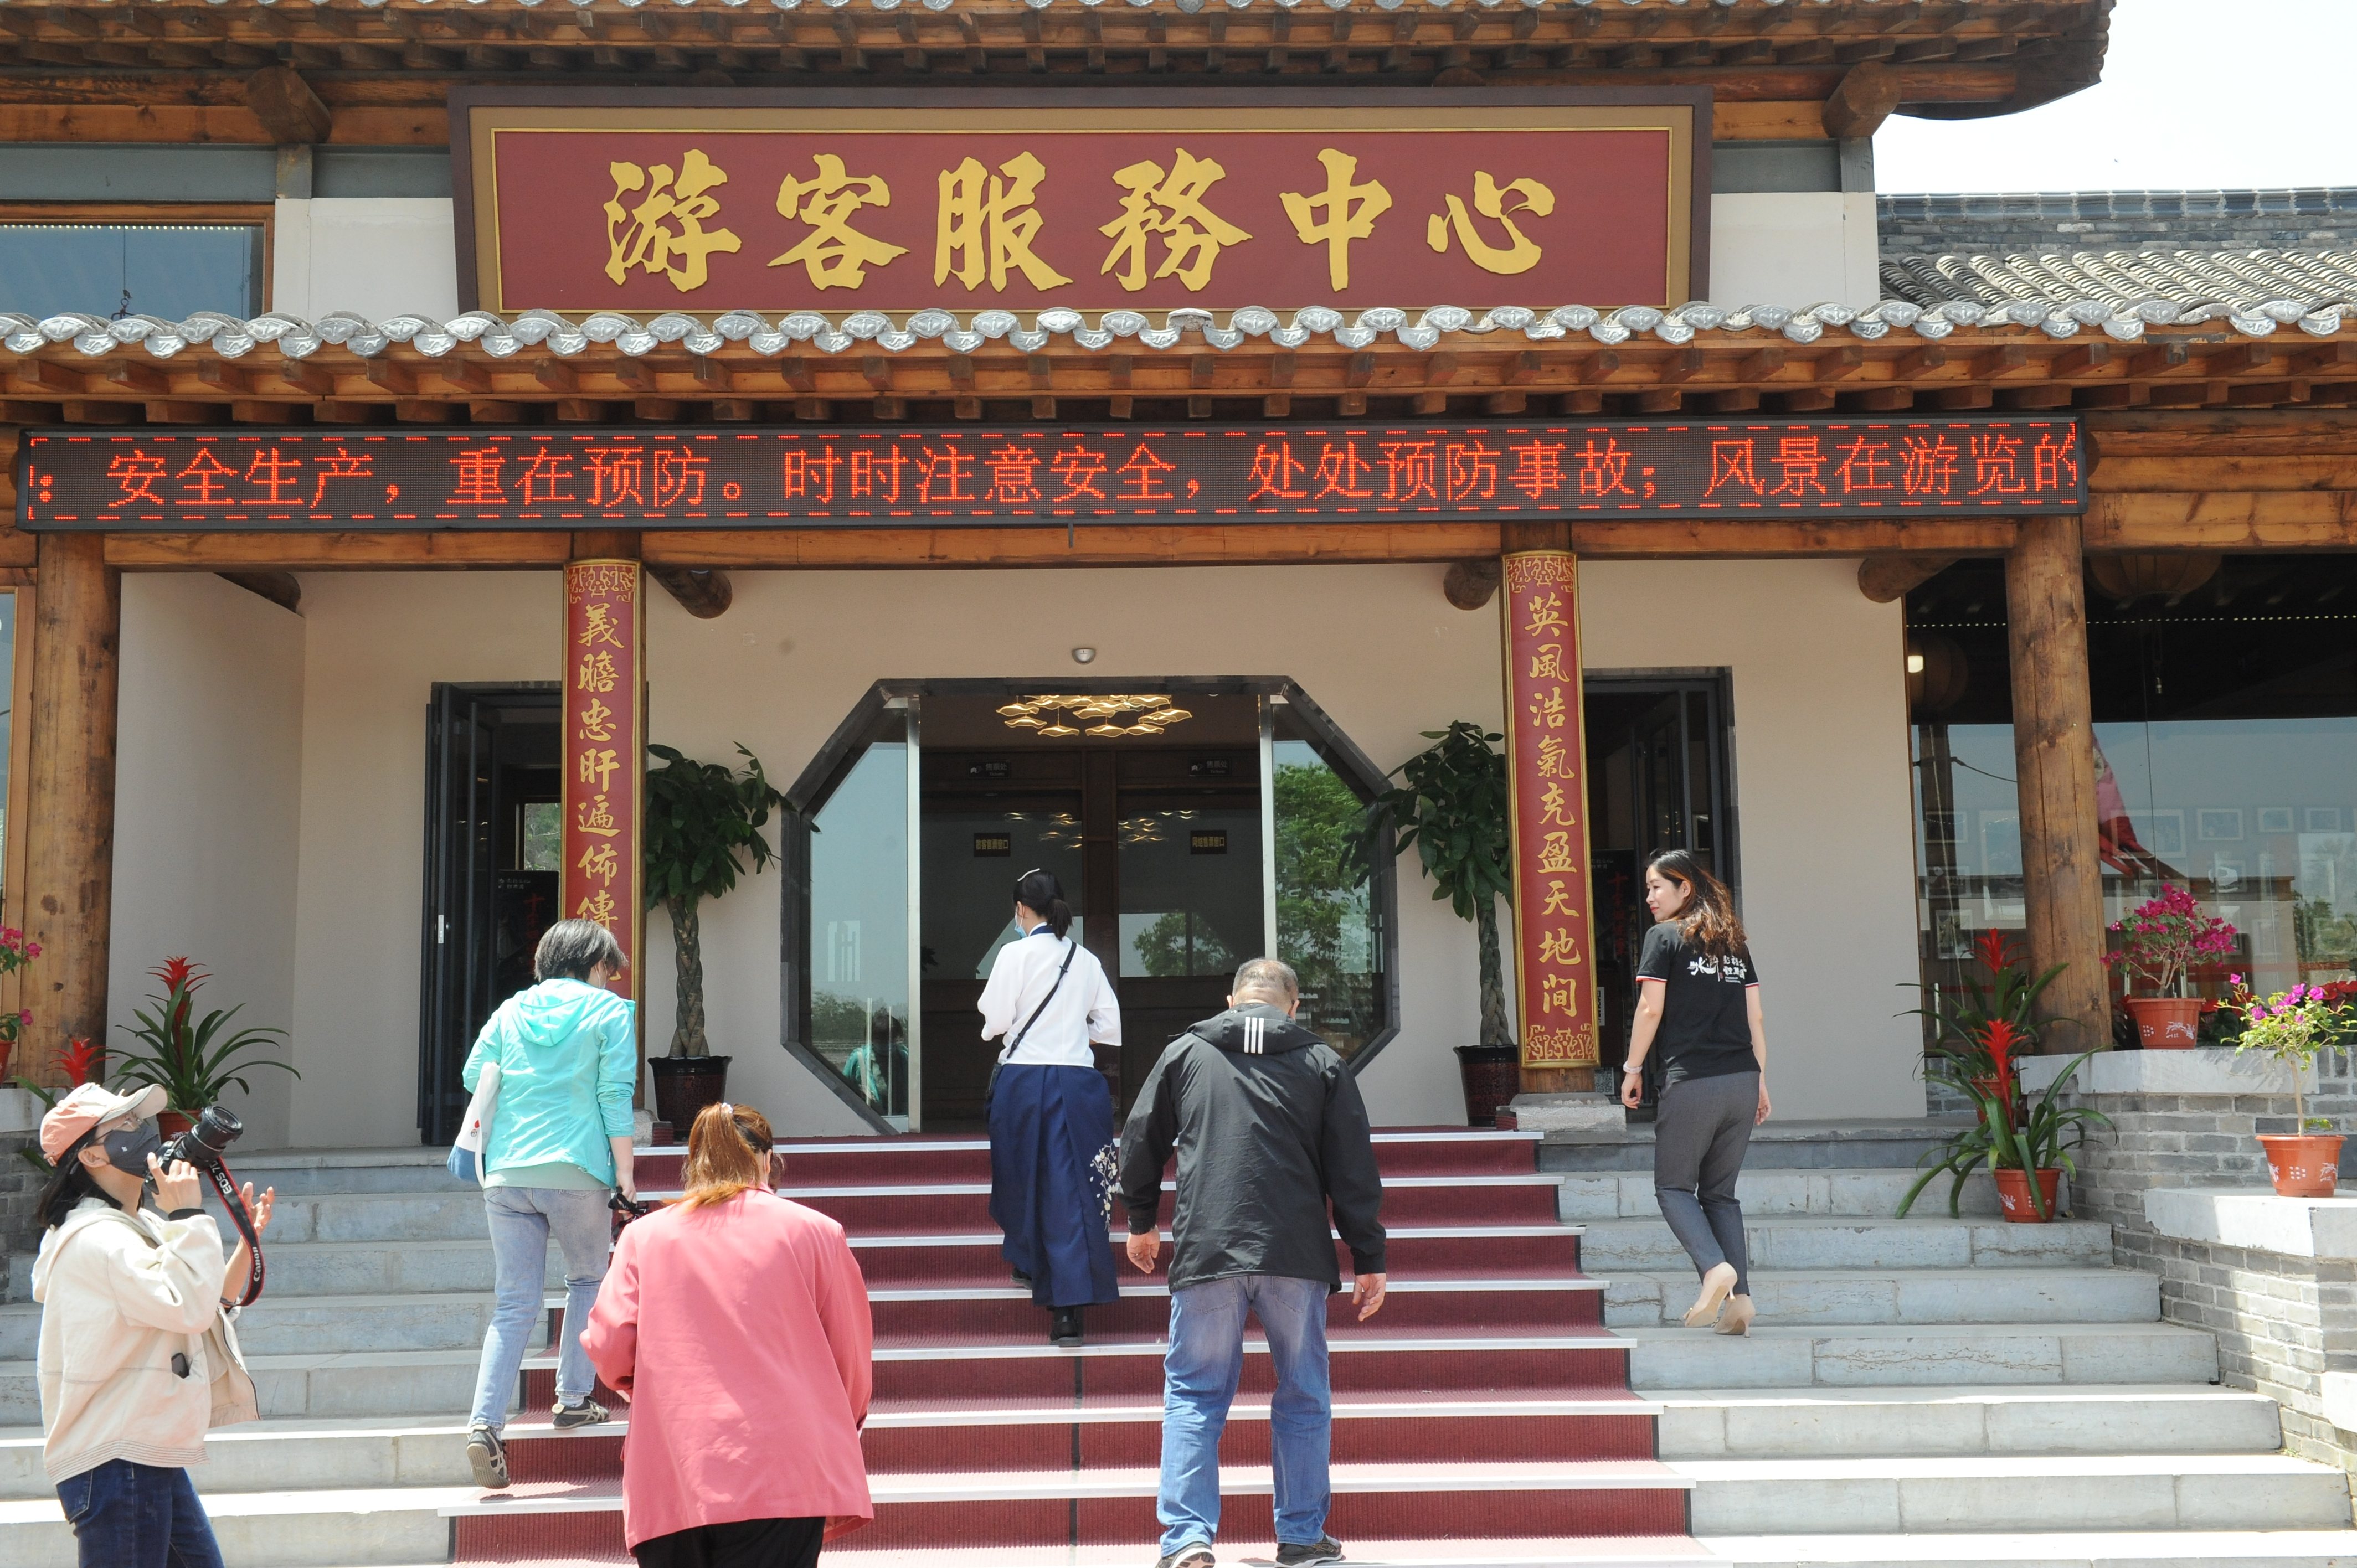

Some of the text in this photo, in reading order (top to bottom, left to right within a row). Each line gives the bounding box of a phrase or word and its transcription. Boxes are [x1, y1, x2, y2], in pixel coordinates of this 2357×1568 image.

[604, 147, 1556, 293] 游客服務中心
[578, 603, 624, 981] 義膽忠肝遍佈傳
[215, 1172, 233, 1194] EOS
